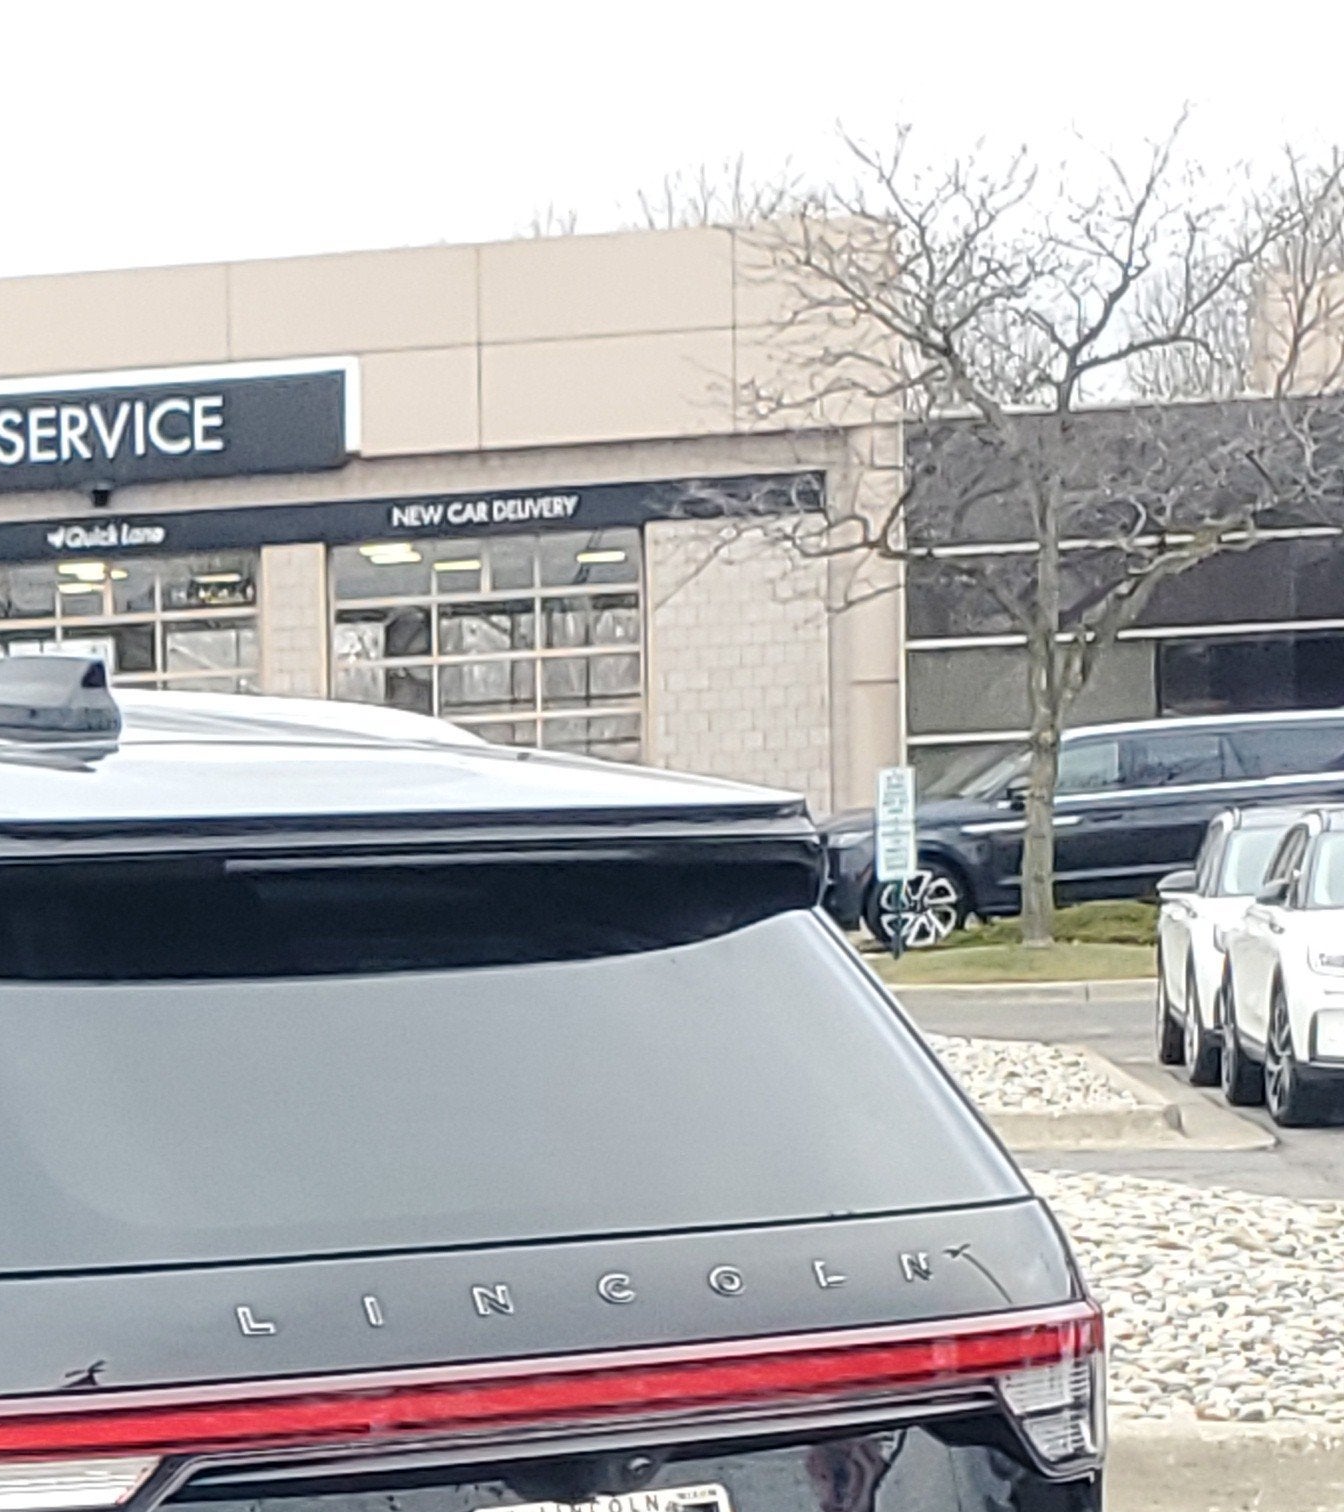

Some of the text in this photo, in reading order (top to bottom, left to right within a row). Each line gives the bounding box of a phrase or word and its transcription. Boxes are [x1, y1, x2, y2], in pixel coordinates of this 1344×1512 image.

[392, 496, 580, 527] NEW CAR DELIVERY
[65, 523, 165, 548] Quick Lane
[236, 1251, 932, 1338] LINCOLN
